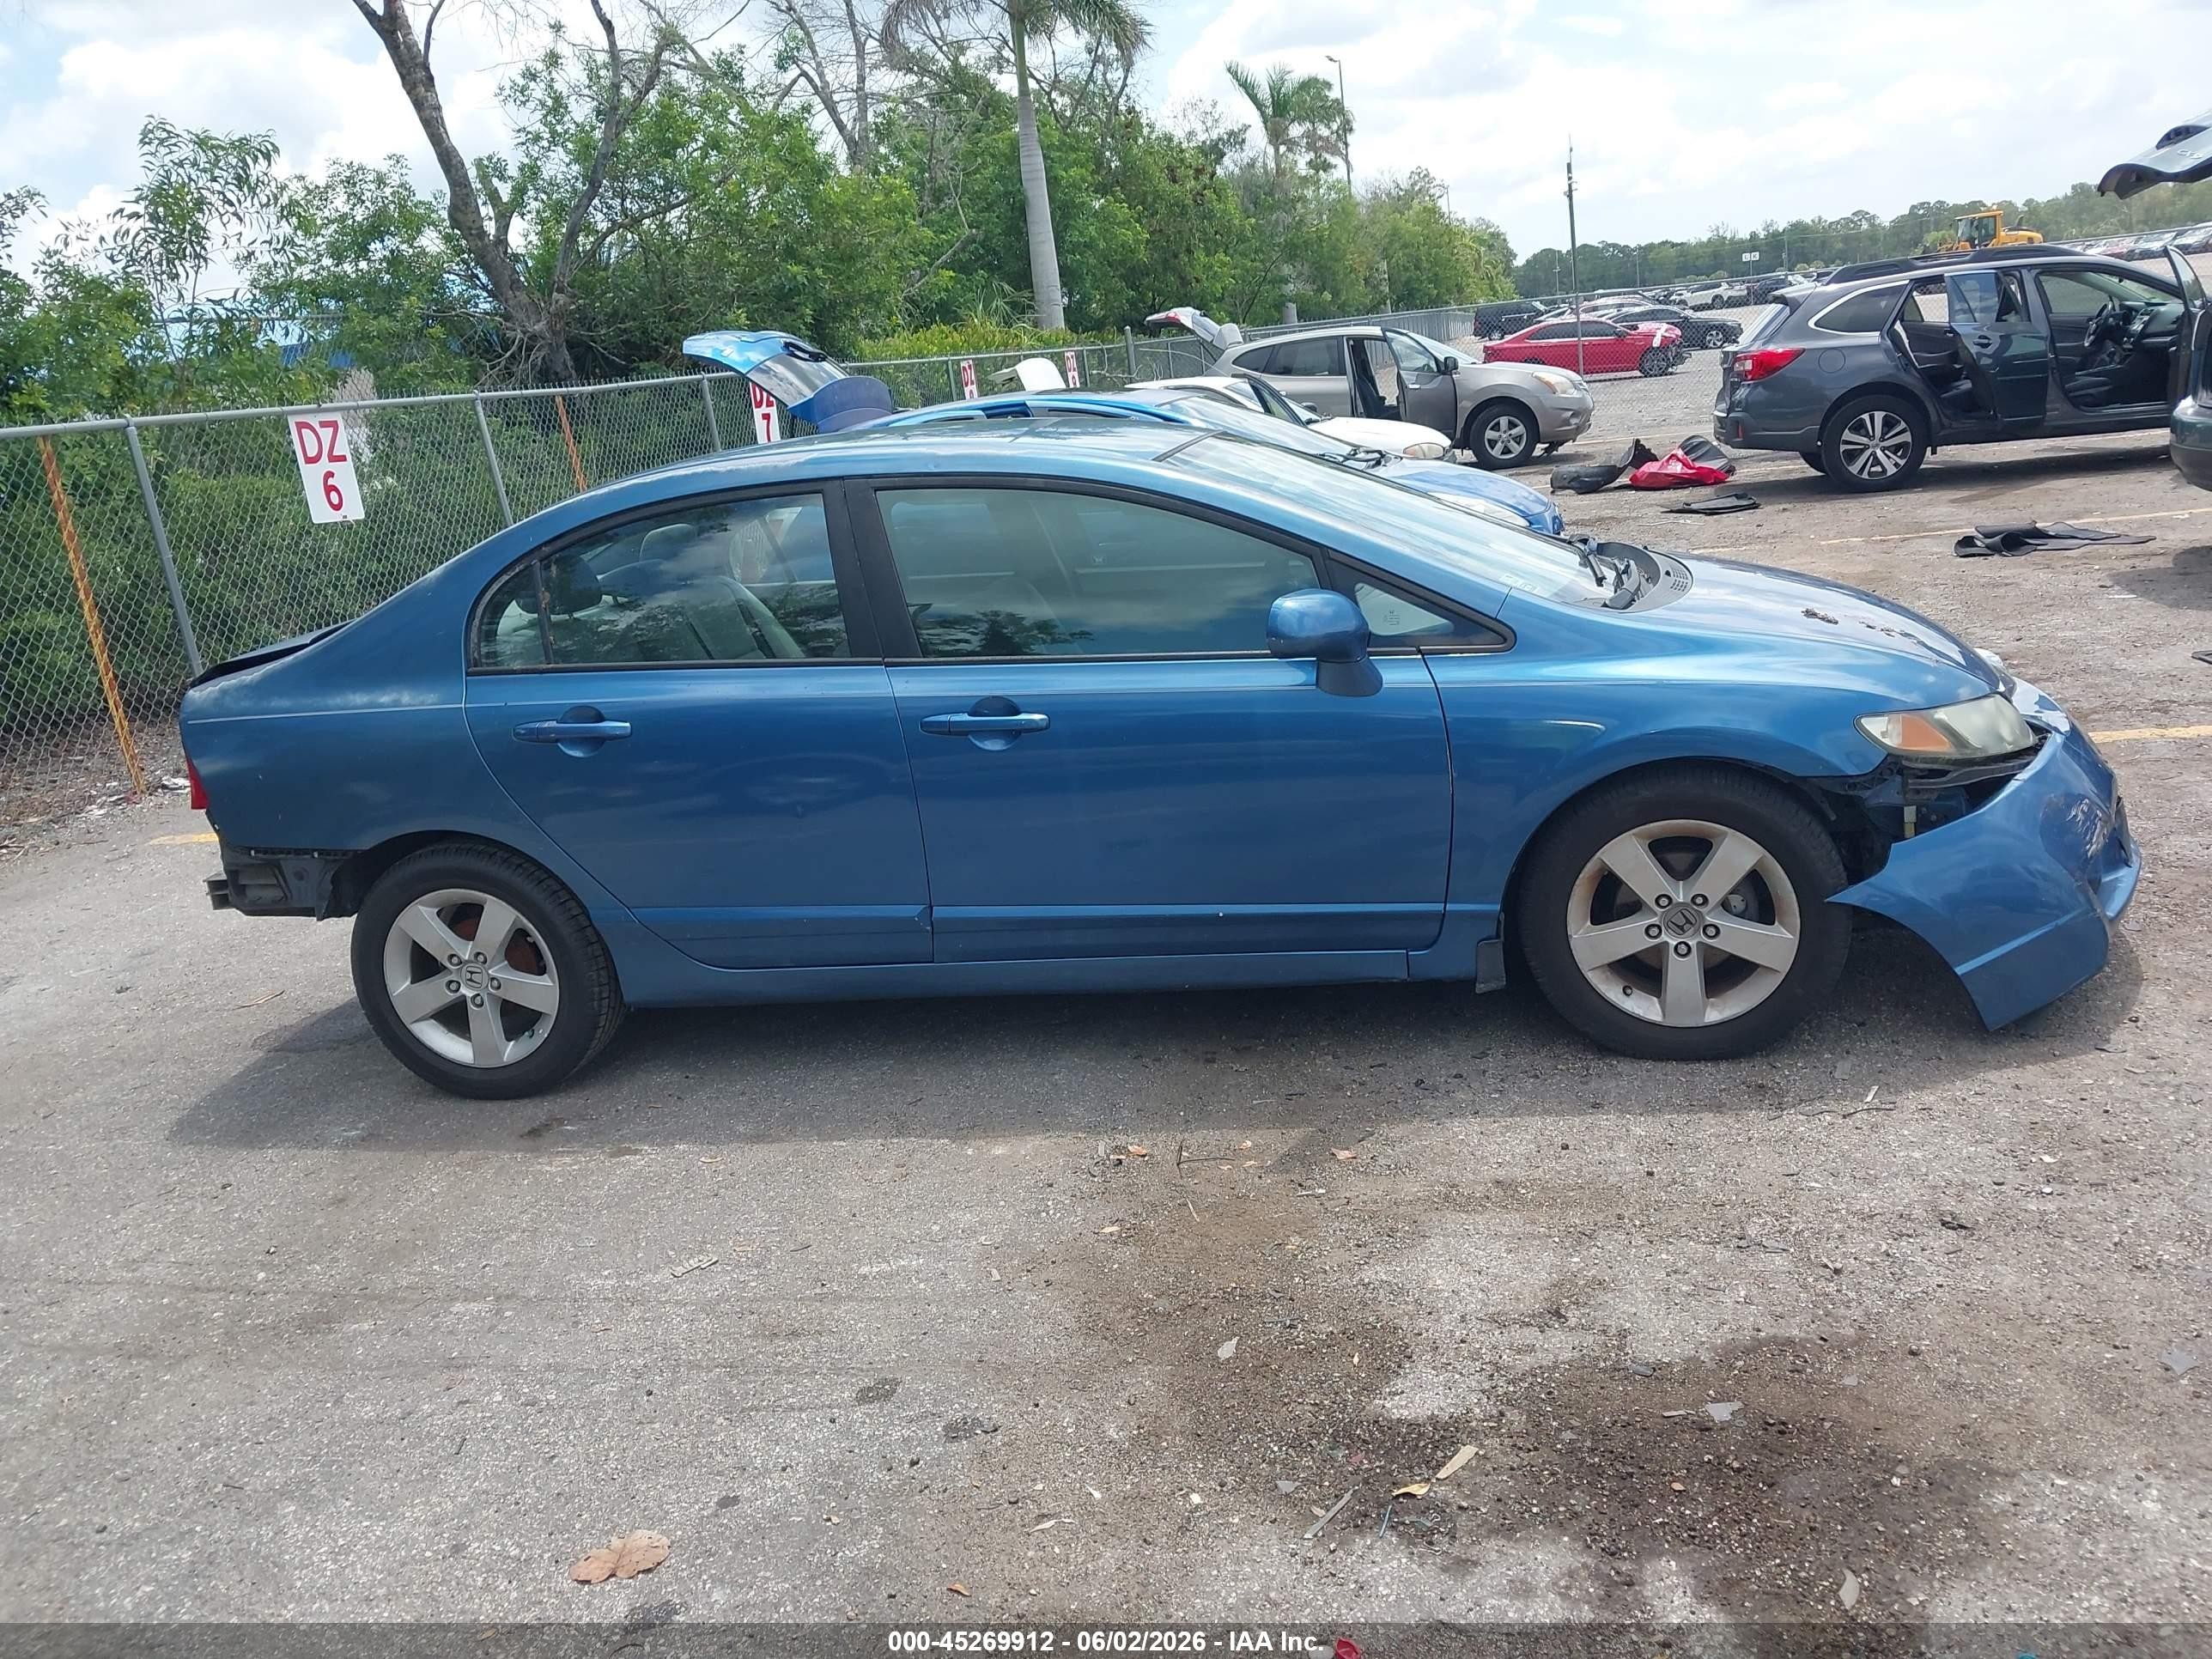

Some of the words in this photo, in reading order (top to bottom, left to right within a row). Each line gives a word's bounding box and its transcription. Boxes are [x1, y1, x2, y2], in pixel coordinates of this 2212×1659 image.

[962, 363, 975, 387] DZ
[1066, 355, 1077, 373] DZ
[761, 412, 771, 442] 7
[295, 420, 348, 465] DZ
[322, 470, 343, 512] 6
